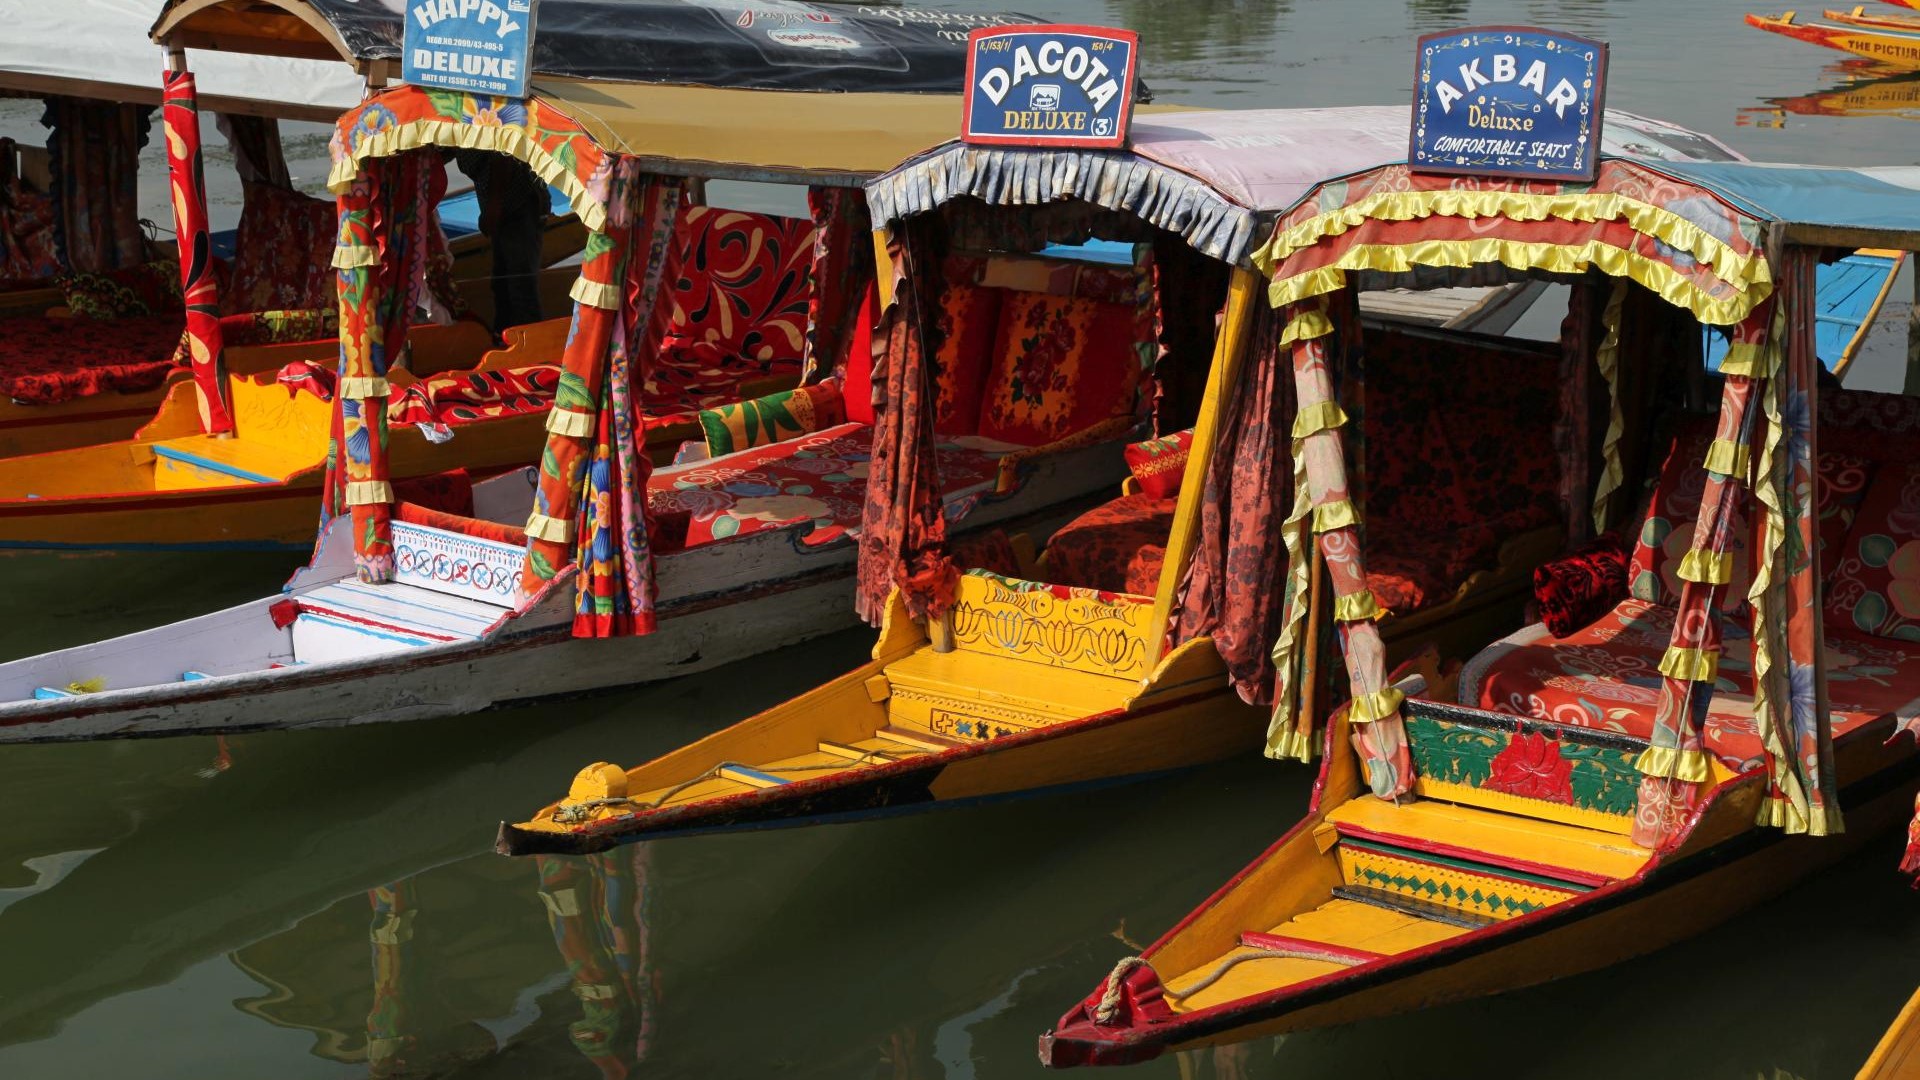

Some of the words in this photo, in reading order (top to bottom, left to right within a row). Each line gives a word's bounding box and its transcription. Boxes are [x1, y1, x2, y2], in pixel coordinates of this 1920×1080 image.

[413, 0, 521, 39] HAPPY
[1848, 40, 1871, 52] THE
[1874, 43, 1920, 60] PICTUR
[413, 48, 517, 80] DELUXE
[979, 40, 1119, 113] DACOTA
[421, 73, 438, 83] DATE
[438, 75, 448, 84] OF
[1435, 54, 1578, 120] AKBAR
[1003, 110, 1087, 131] DELUXE
[1090, 116, 1113, 136] (3)
[1468, 105, 1534, 132] Deluxe
[1433, 135, 1527, 156] COMFORTABLE
[1528, 140, 1573, 159] SEATS
